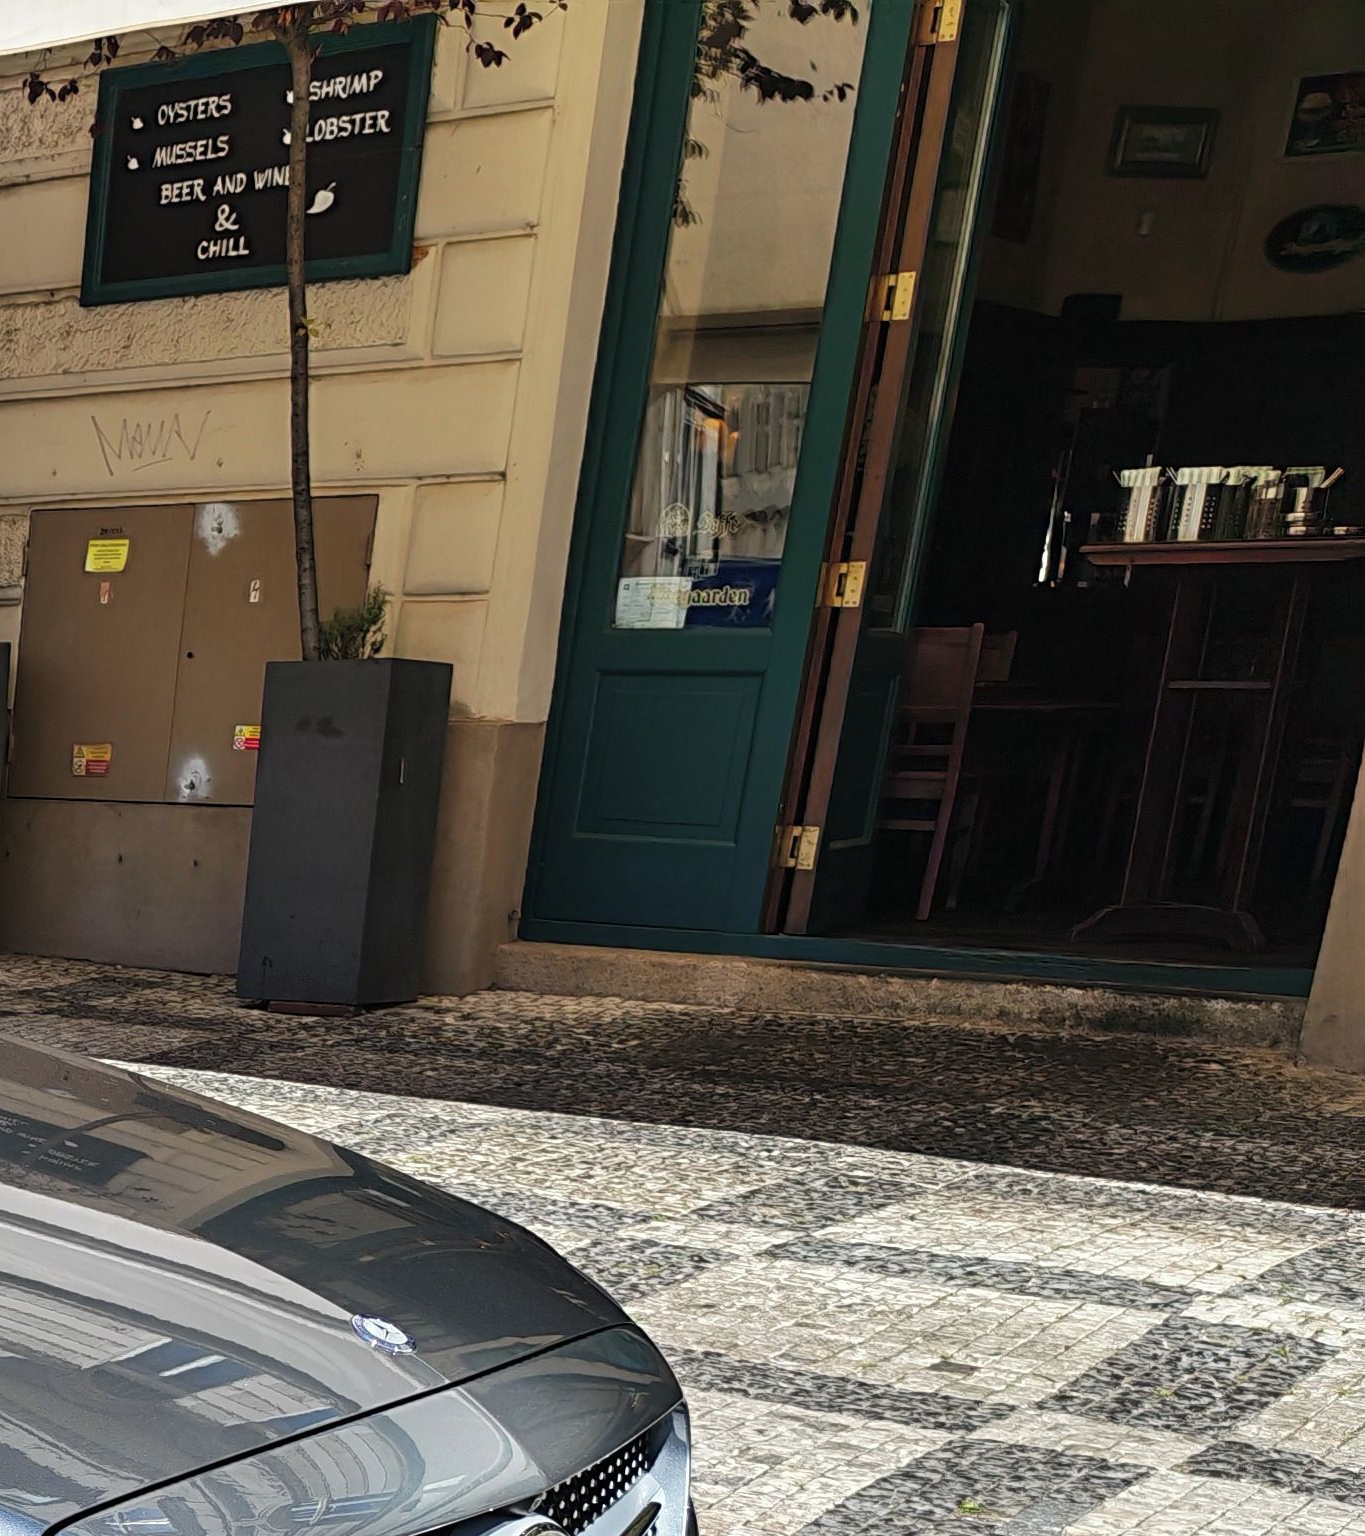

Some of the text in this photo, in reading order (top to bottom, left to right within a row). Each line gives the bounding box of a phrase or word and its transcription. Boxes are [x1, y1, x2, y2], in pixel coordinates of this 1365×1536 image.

[309, 70, 383, 101] SHRIMP
[158, 94, 232, 126] OYSTERS
[305, 110, 391, 143] LOBSTER
[152, 136, 229, 168] MUSSELS
[160, 178, 206, 205] BEER
[213, 173, 246, 198] AND
[215, 204, 239, 231] &
[197, 236, 249, 260] CHILL
